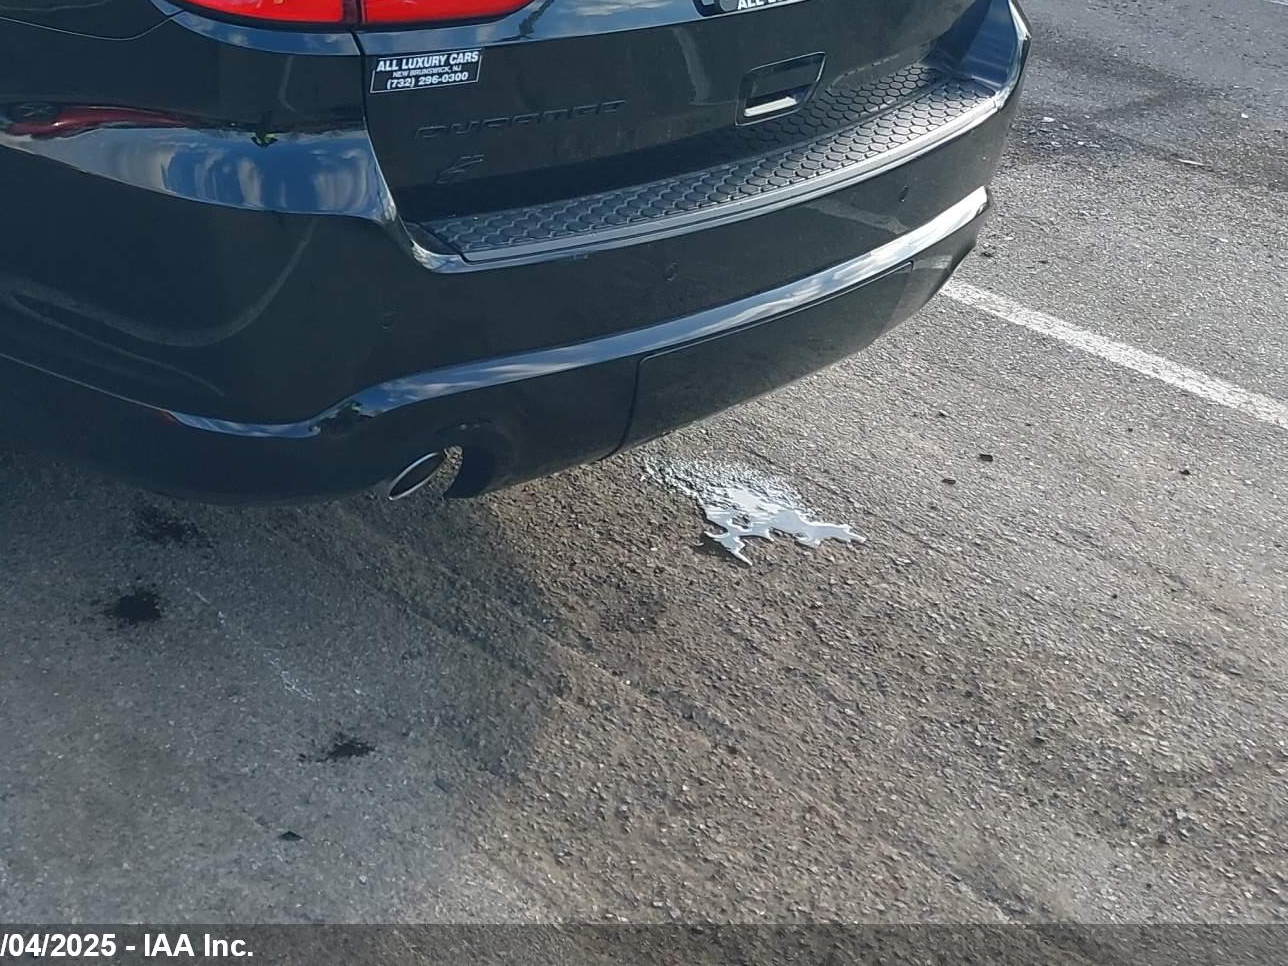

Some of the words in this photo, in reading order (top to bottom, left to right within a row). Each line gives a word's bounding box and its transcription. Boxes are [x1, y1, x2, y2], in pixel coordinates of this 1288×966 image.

[376, 59, 401, 72] ALL
[401, 54, 448, 70] LUXURY
[449, 51, 480, 64] CARS
[386, 77, 416, 90] (732)
[417, 71, 469, 86] 296-0300
